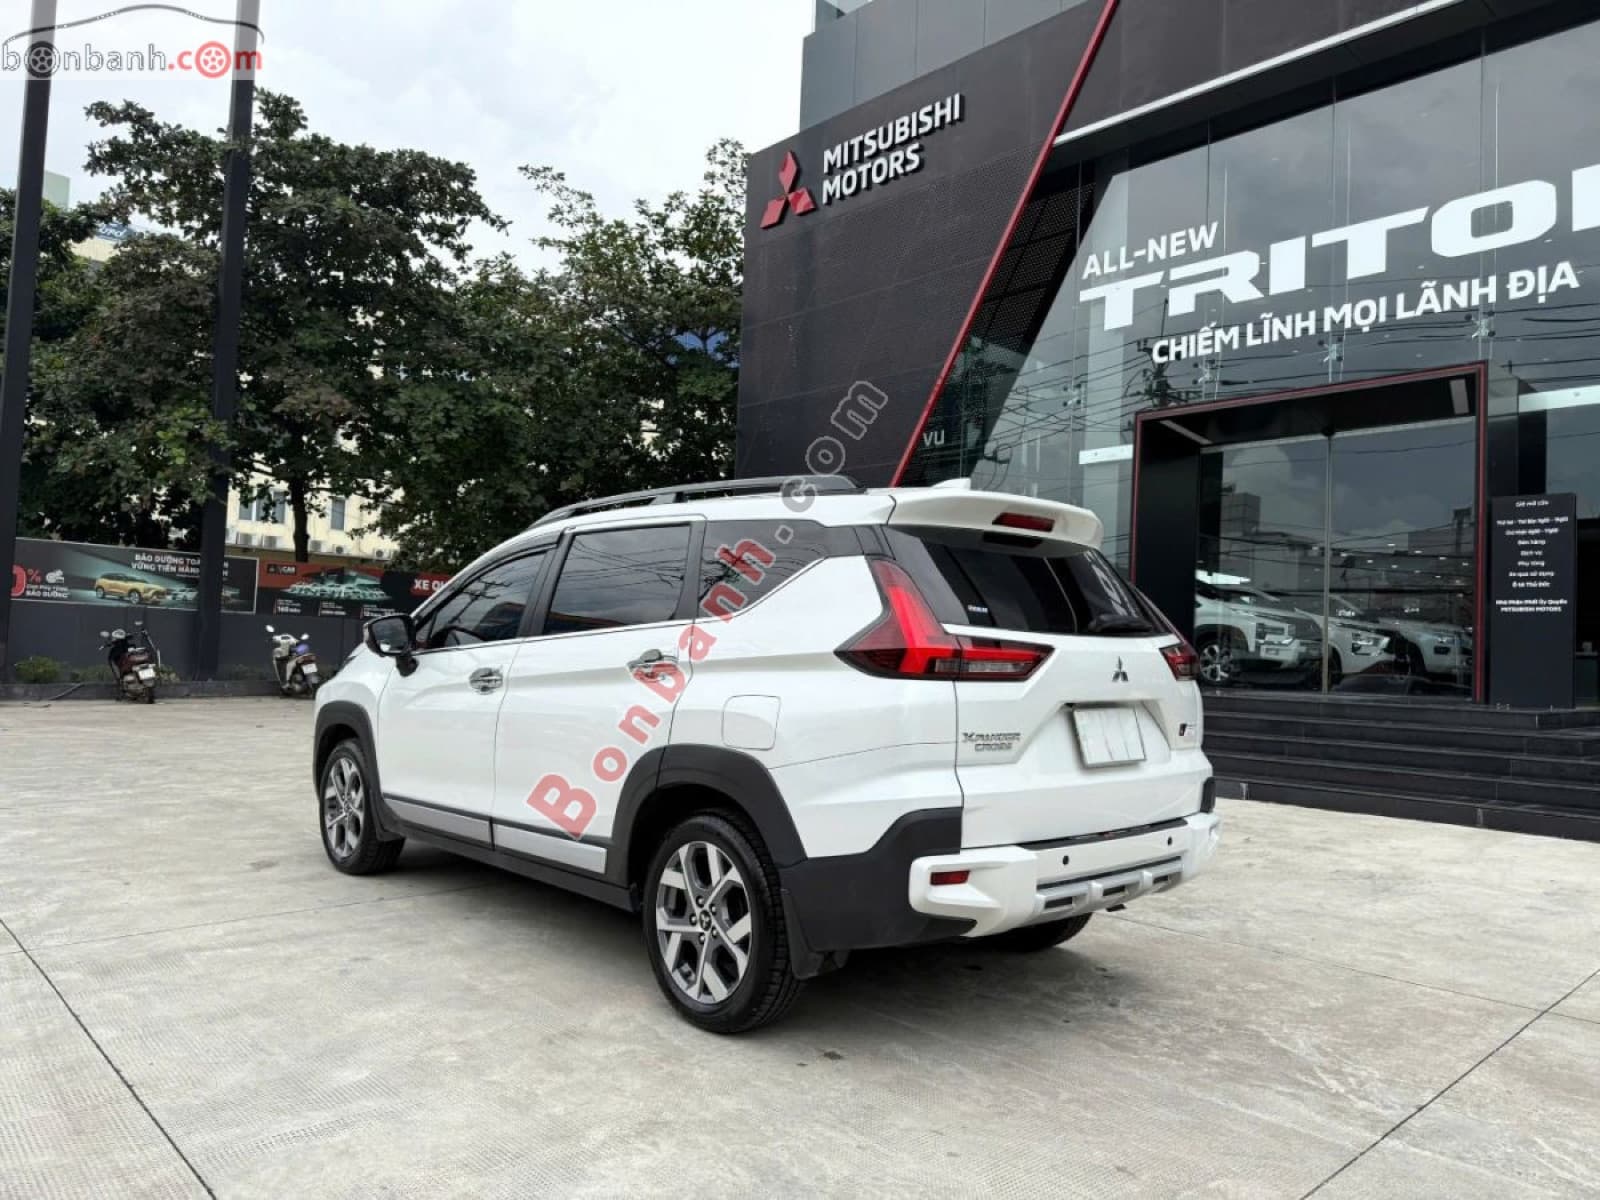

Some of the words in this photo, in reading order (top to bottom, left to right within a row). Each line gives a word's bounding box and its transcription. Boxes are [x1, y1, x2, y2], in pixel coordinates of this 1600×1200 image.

[823, 92, 962, 174] MITSUBISHI
[822, 142, 922, 206] MOTORS
[1082, 221, 1218, 280] ALL-NEW
[1151, 322, 1240, 364] CHIẾM
[1245, 308, 1316, 347] LĨNH
[1323, 298, 1387, 334] MỌI
[1396, 272, 1497, 321] LÃNH
[1506, 260, 1580, 304] ĐỊA
[414, 579, 430, 590] XE
